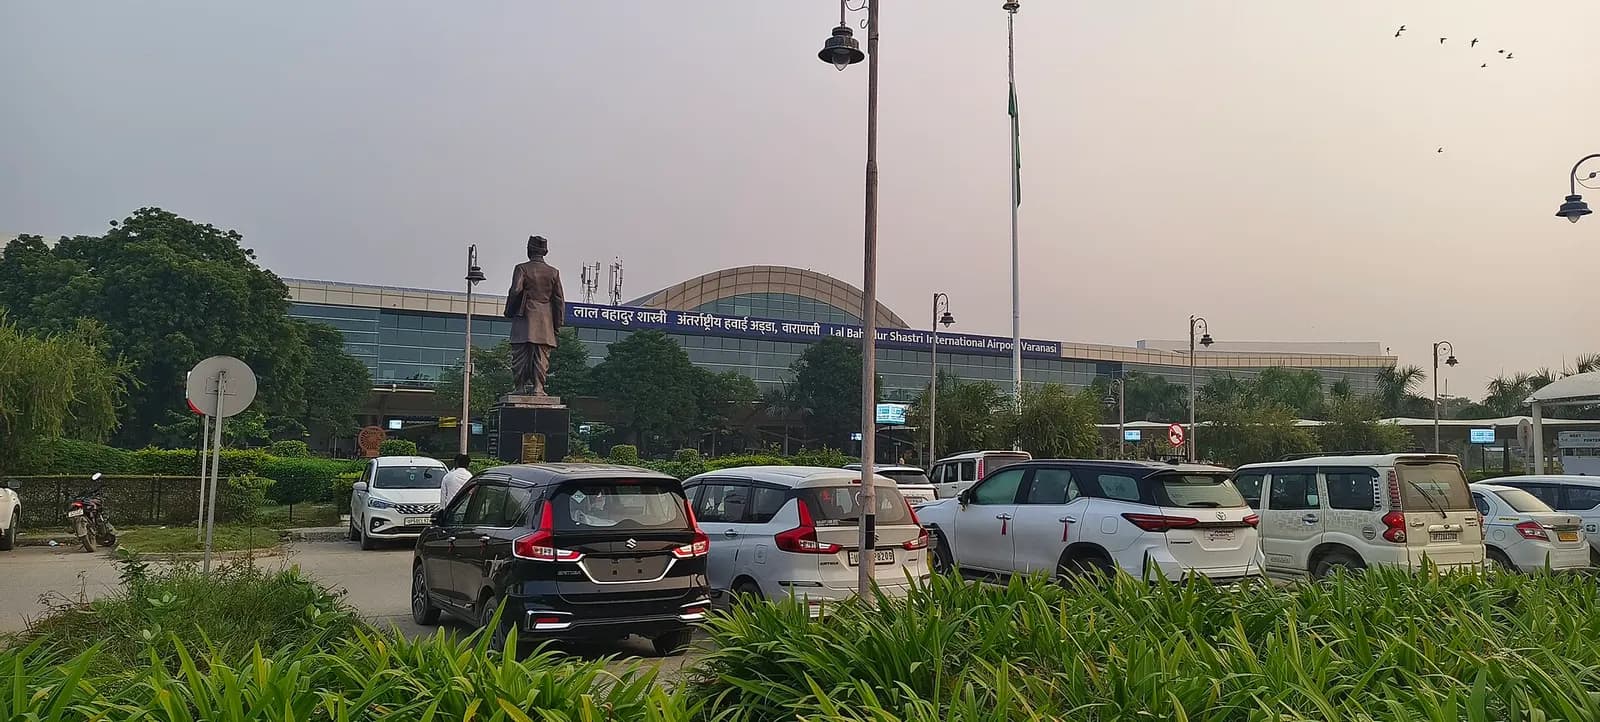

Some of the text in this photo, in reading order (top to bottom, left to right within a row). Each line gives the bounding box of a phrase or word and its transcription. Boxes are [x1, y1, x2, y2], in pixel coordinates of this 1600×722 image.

[573, 306, 598, 319] लाल
[602, 308, 634, 325] बहादुर
[637, 310, 667, 324] शास्त्री
[724, 316, 748, 332] हवाई
[782, 322, 820, 336] वाराणसी
[830, 326, 1056, 353] Lal Bahur Shastri International Airpor Varanasi
